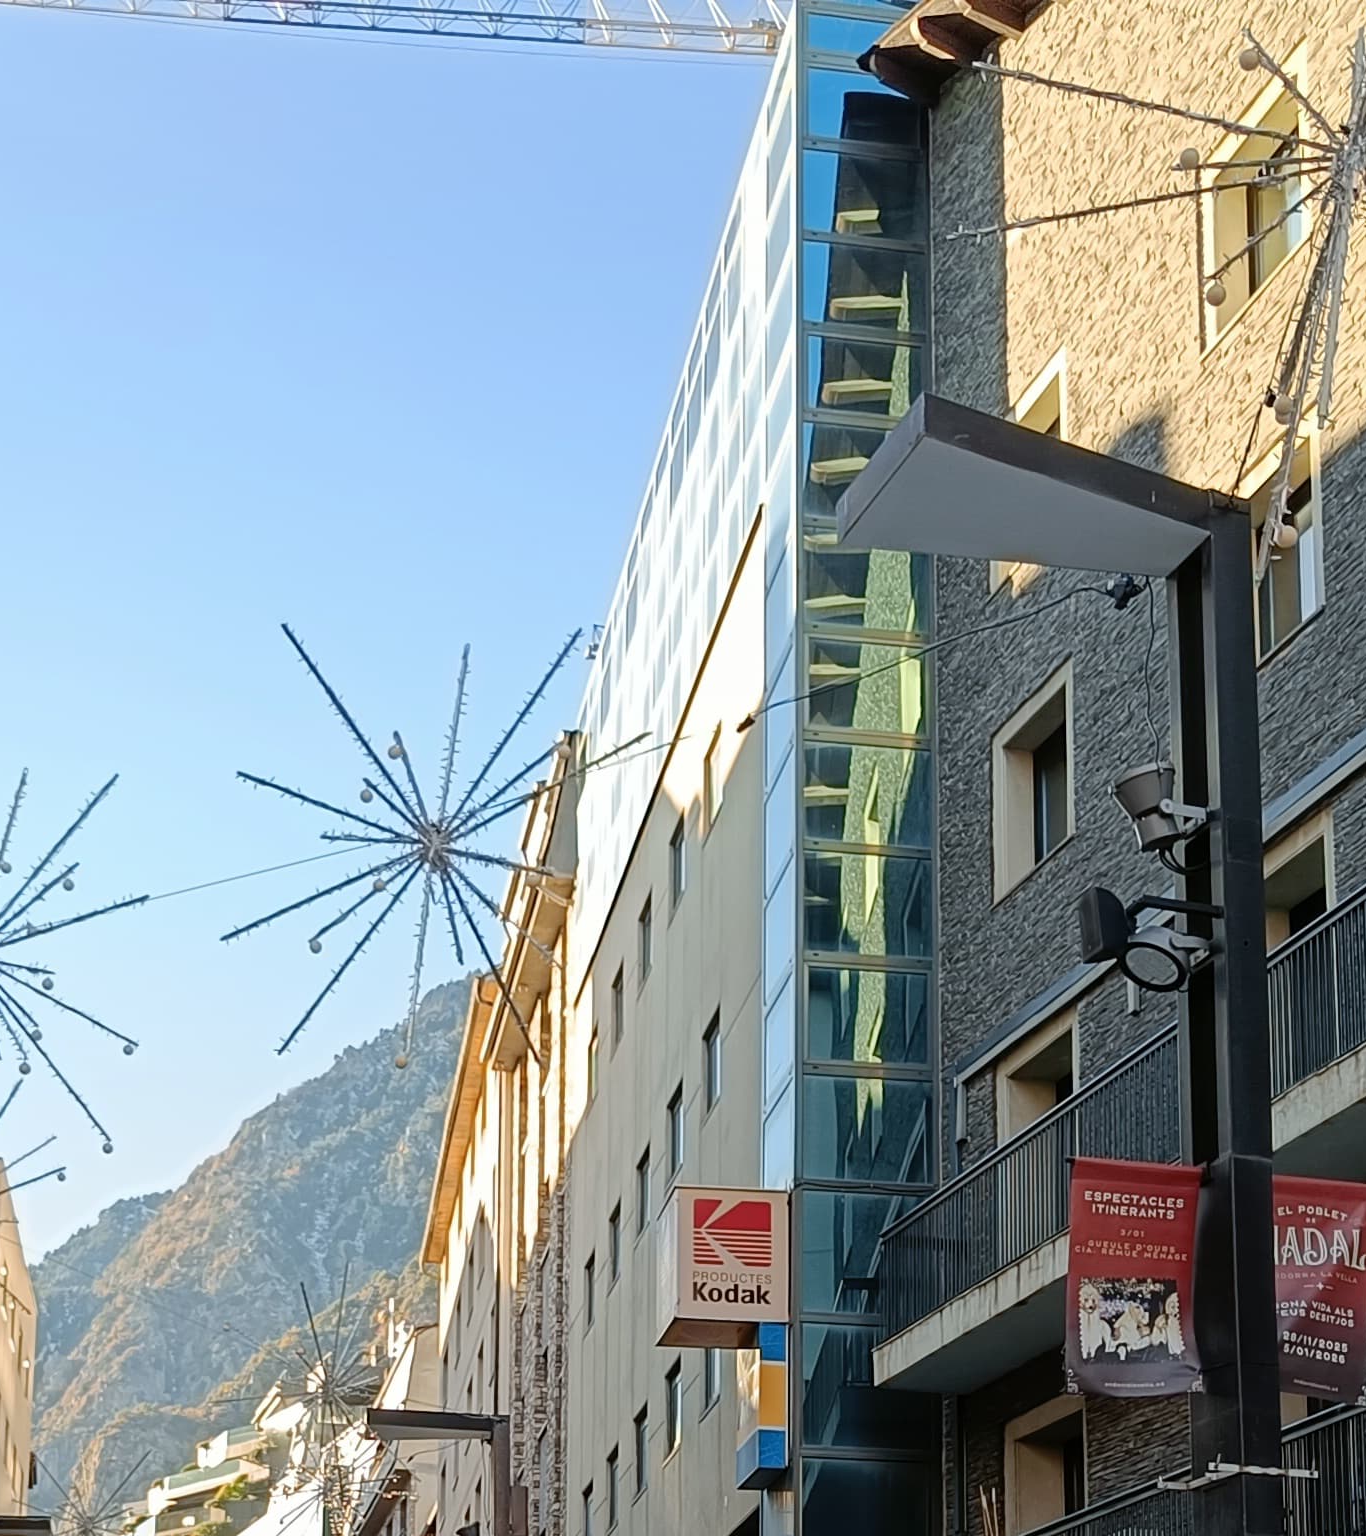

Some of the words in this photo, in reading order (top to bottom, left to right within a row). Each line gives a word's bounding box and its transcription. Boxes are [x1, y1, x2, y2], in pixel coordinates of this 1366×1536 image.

[1084, 1190, 1185, 1208] ESPECTACLES
[1092, 1203, 1175, 1220] ITINERANTS
[1277, 1205, 1293, 1217] EL
[1298, 1204, 1348, 1222] POBLET
[1120, 1229, 1146, 1239] 3/01
[1088, 1239, 1131, 1251] GUEULE
[1136, 1243, 1176, 1254] D'OURS
[1101, 1247, 1139, 1258] REMUE
[692, 1271, 772, 1285] PRODUCTES
[692, 1281, 771, 1305] Kodak
[1311, 1300, 1332, 1314] VIDA
[1334, 1307, 1354, 1318] ALS
[1309, 1309, 1355, 1328] DESITJOS
[1282, 1330, 1348, 1353] 28/11/2025
[1283, 1342, 1346, 1365] 5/01/2026
